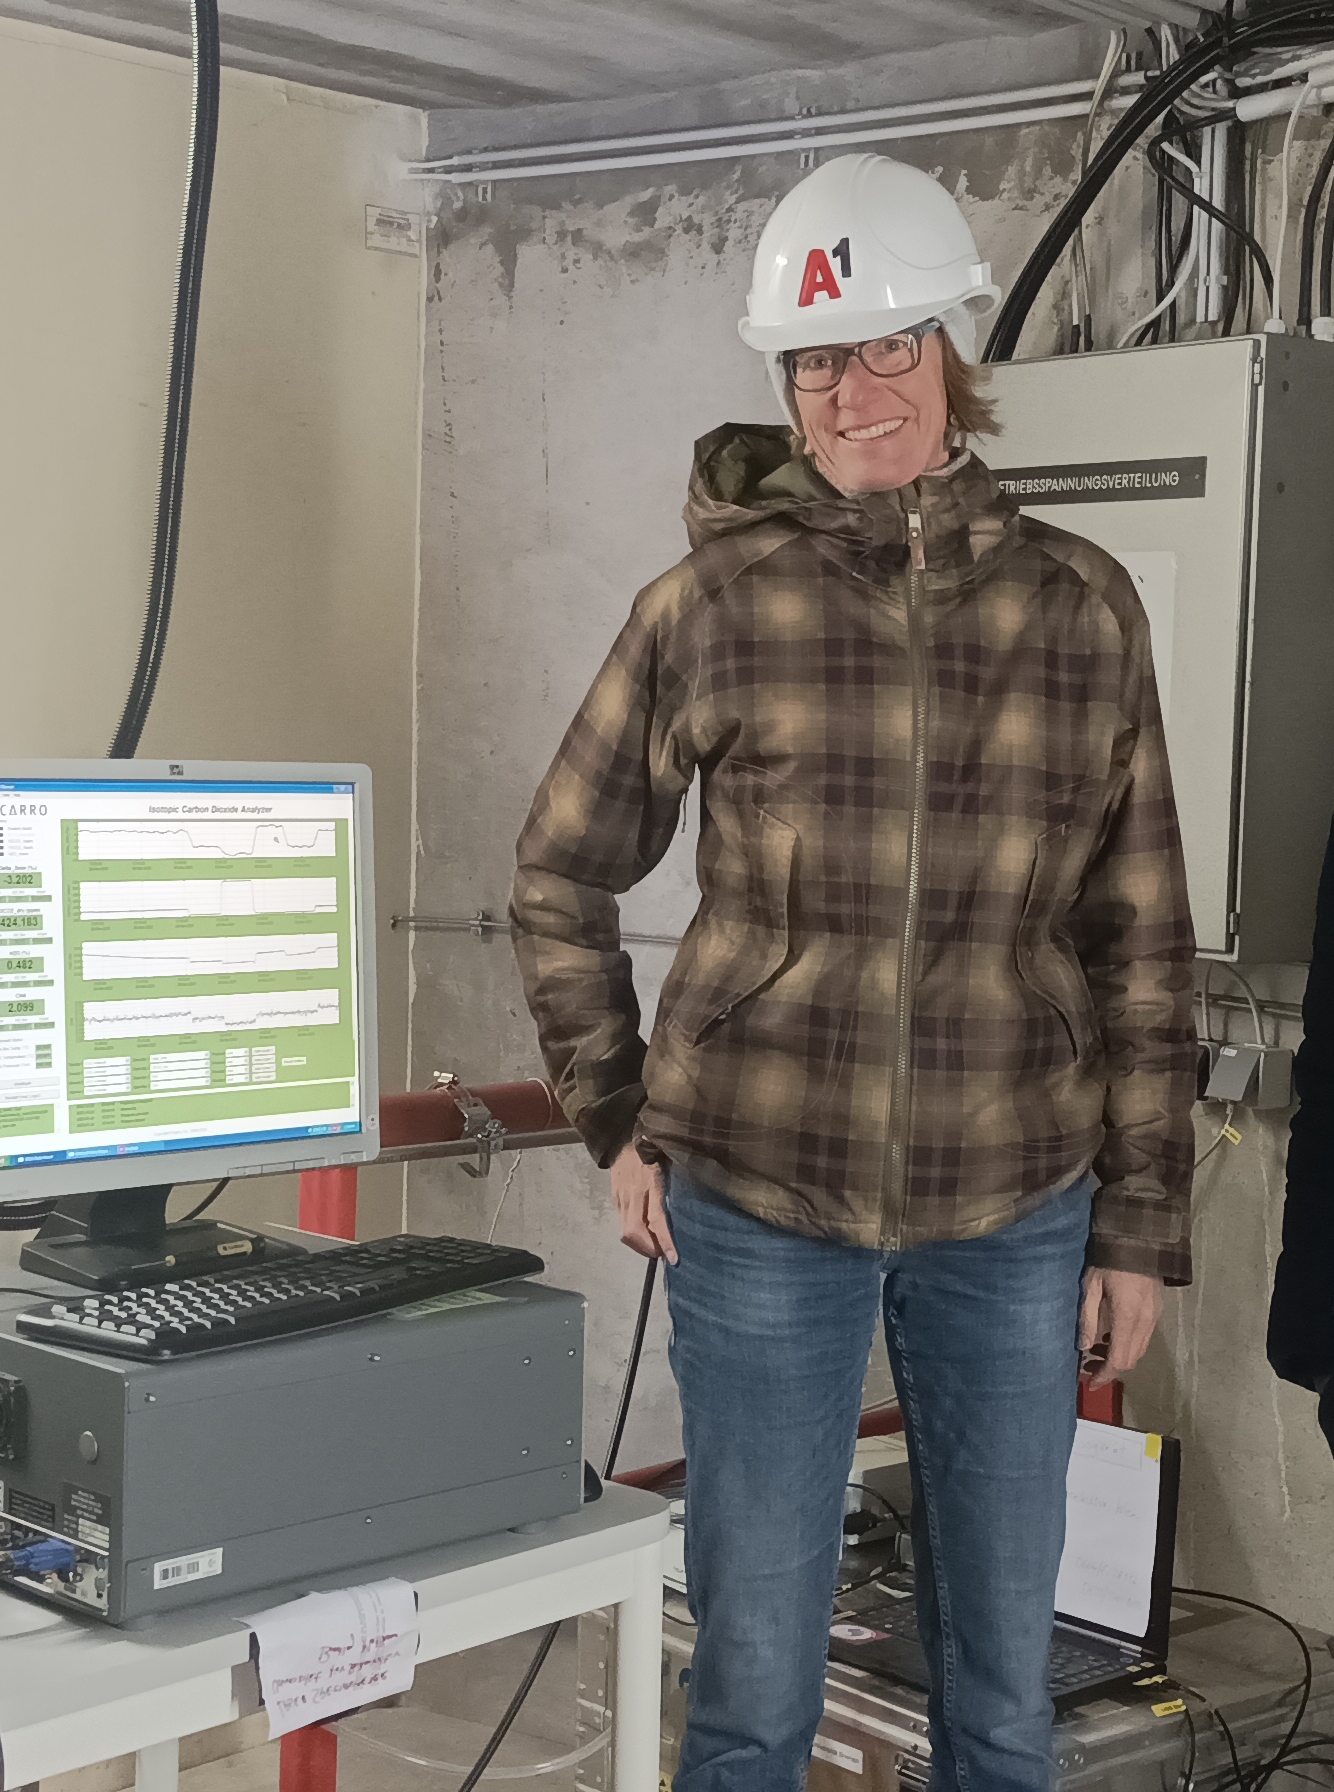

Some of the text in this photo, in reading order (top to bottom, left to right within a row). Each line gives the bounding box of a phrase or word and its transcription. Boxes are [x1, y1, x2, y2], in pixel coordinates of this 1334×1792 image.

[798, 237, 851, 307] A1
[998, 471, 1180, 494] ETRIEBSSPANNUNGSVERTEILUNG
[148, 805, 273, 814] Isotopic Carbon Dioxide Analyzer
[3, 874, 34, 885] -3.202
[0, 916, 38, 928] 424.183
[6, 959, 34, 970] 0.482
[7, 1002, 35, 1013] 2.099
